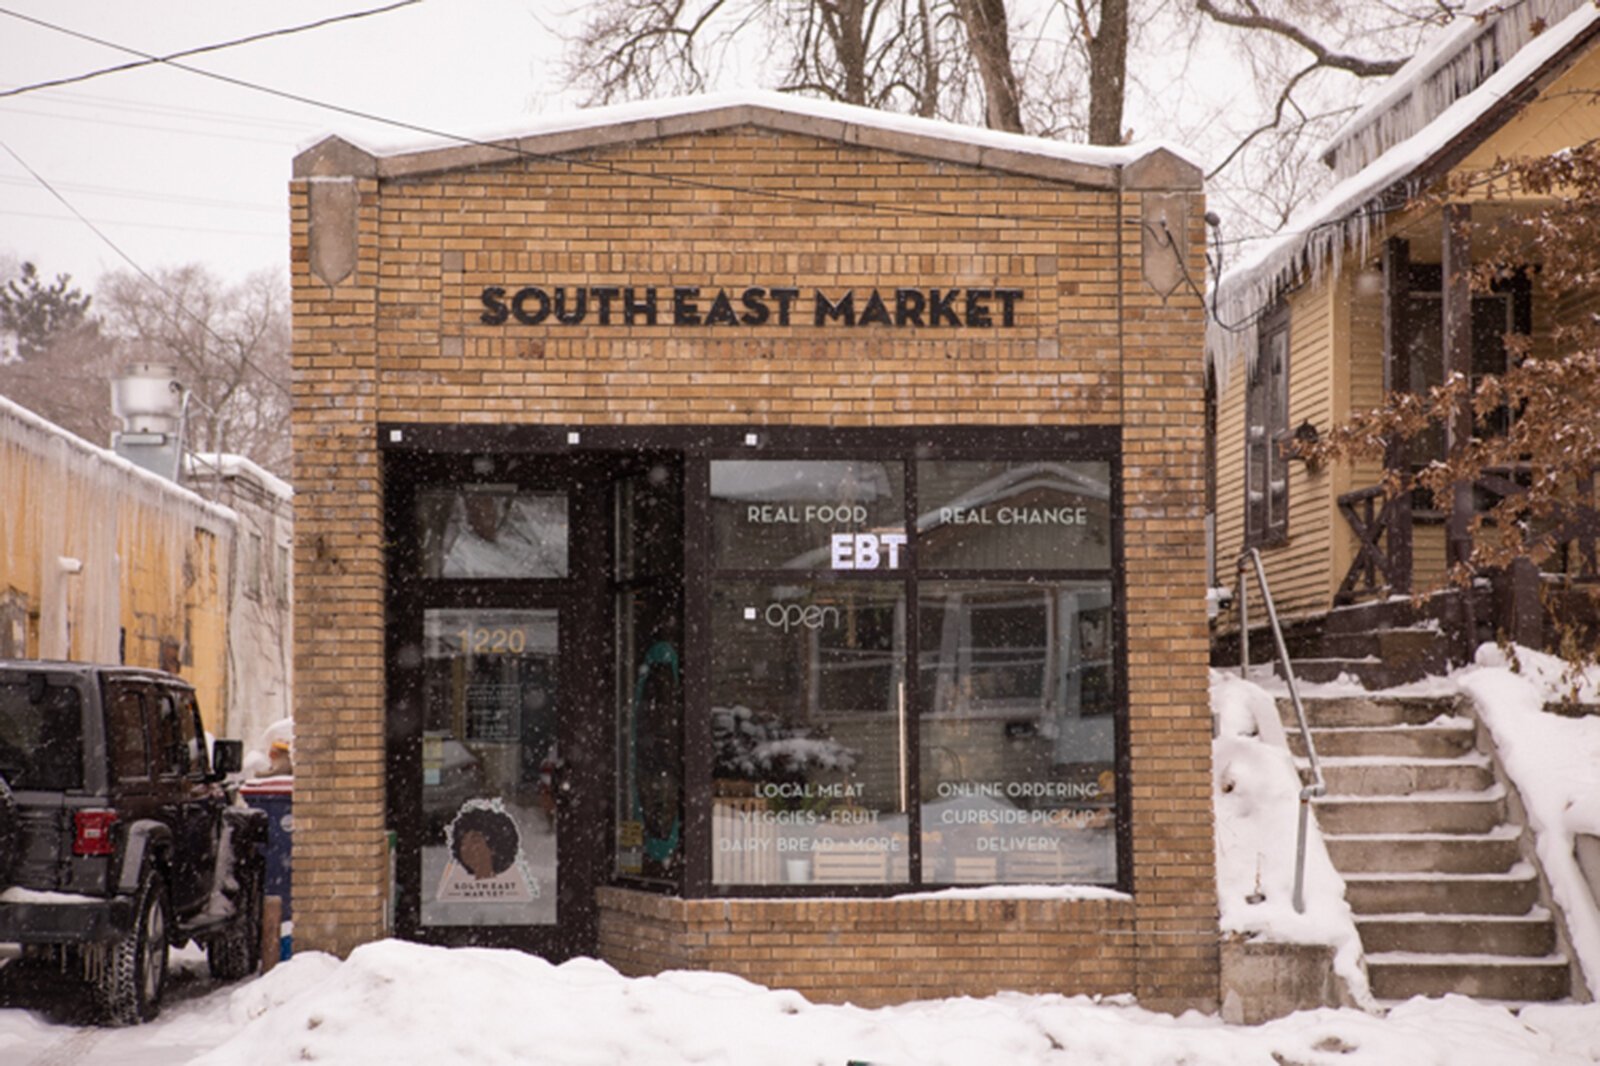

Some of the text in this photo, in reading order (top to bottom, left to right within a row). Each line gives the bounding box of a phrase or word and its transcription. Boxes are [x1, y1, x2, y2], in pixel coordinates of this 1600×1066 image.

[480, 286, 1024, 328] SOUTH EAST MARKET
[748, 506, 867, 522] REAL FOOD
[939, 507, 1087, 525] REAL CHANGE
[831, 533, 907, 570] EBT
[765, 603, 840, 633] open
[457, 629, 526, 653] 1220
[755, 782, 865, 798] LOCAL MEAT
[937, 782, 1100, 798] ONLINE ORDERING
[740, 810, 880, 825] VEGGIES FRUIT
[941, 809, 1096, 825] CURBSIDE PICKUP
[719, 837, 900, 852] DAIRY BREAD MORE
[976, 836, 1061, 851] DELIVERY
